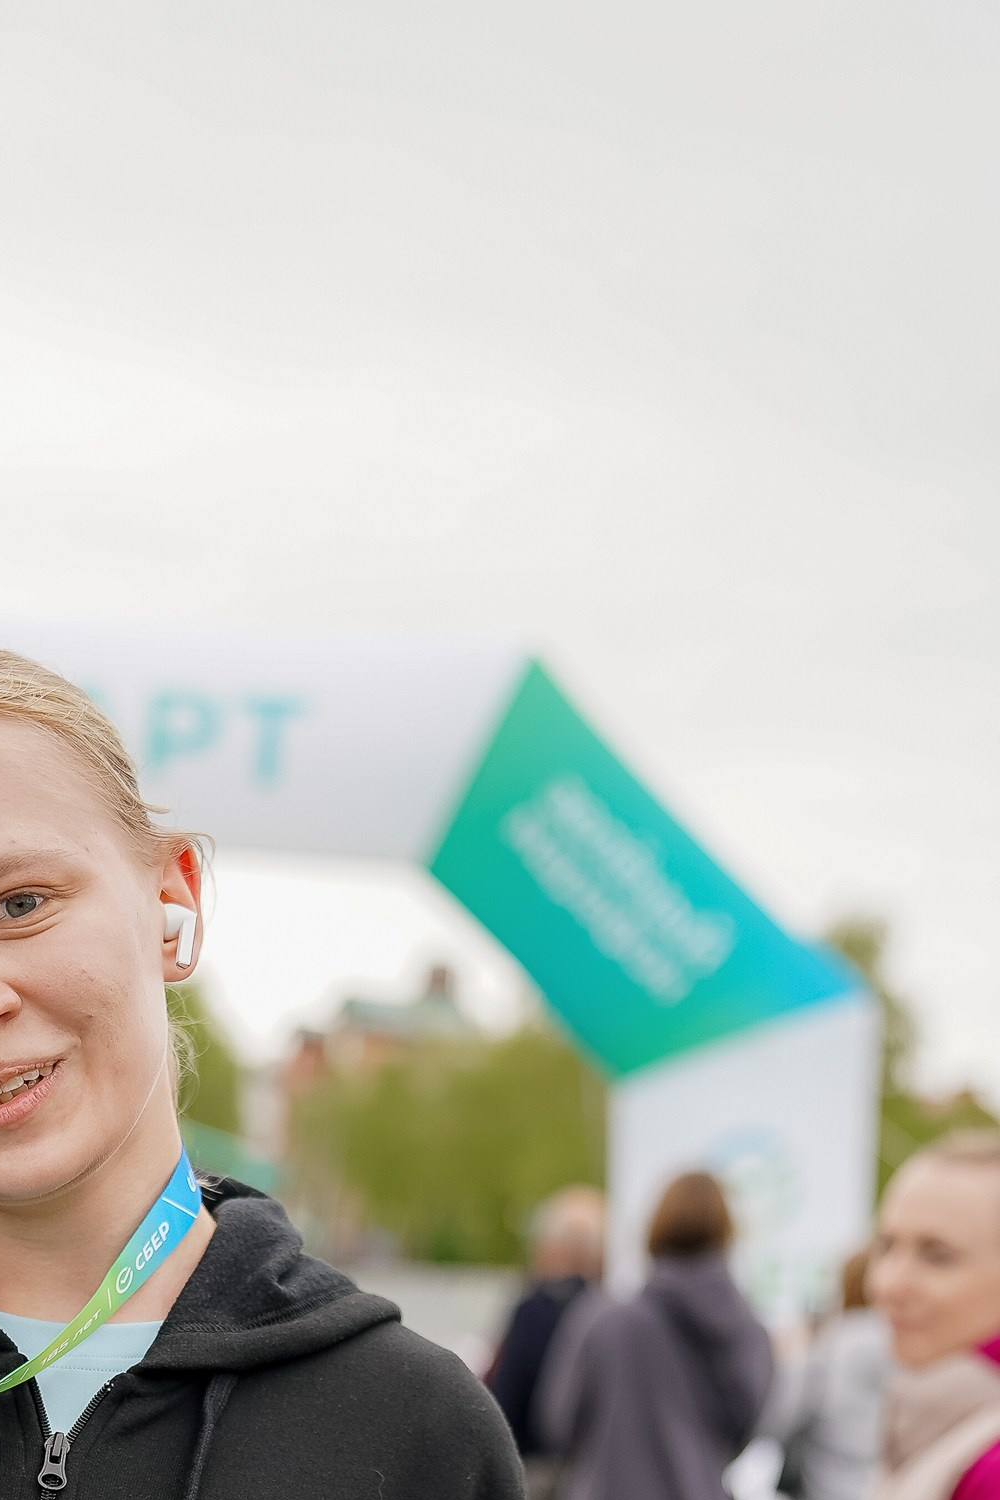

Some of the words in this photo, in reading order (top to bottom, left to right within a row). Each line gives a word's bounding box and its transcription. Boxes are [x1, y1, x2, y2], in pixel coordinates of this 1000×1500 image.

[85, 686, 312, 785] РТ
[135, 1221, 170, 1271] СБЕР
[73, 1308, 101, 1341] лет
